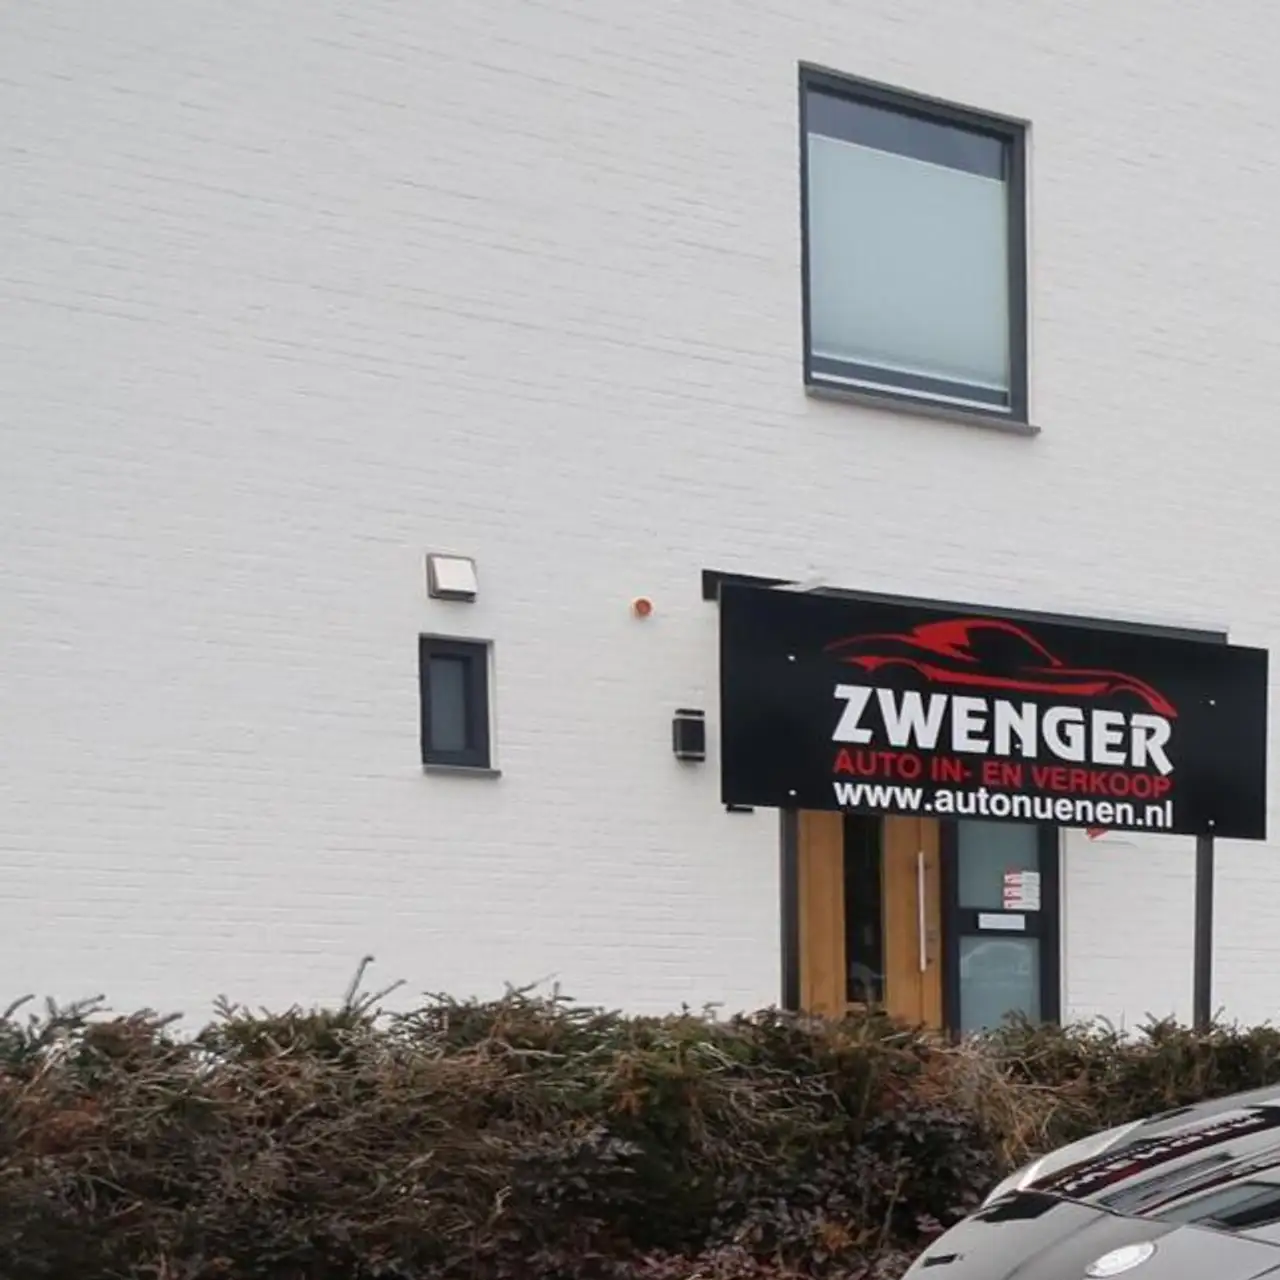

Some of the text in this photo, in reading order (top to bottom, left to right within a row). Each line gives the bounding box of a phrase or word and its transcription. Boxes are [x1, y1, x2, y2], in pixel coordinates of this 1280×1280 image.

[831, 683, 1175, 776] ZWENGER
[833, 748, 1172, 799] AUTO IN- EN VERKOOP
[832, 781, 1174, 828] www.autonuenen.nl
